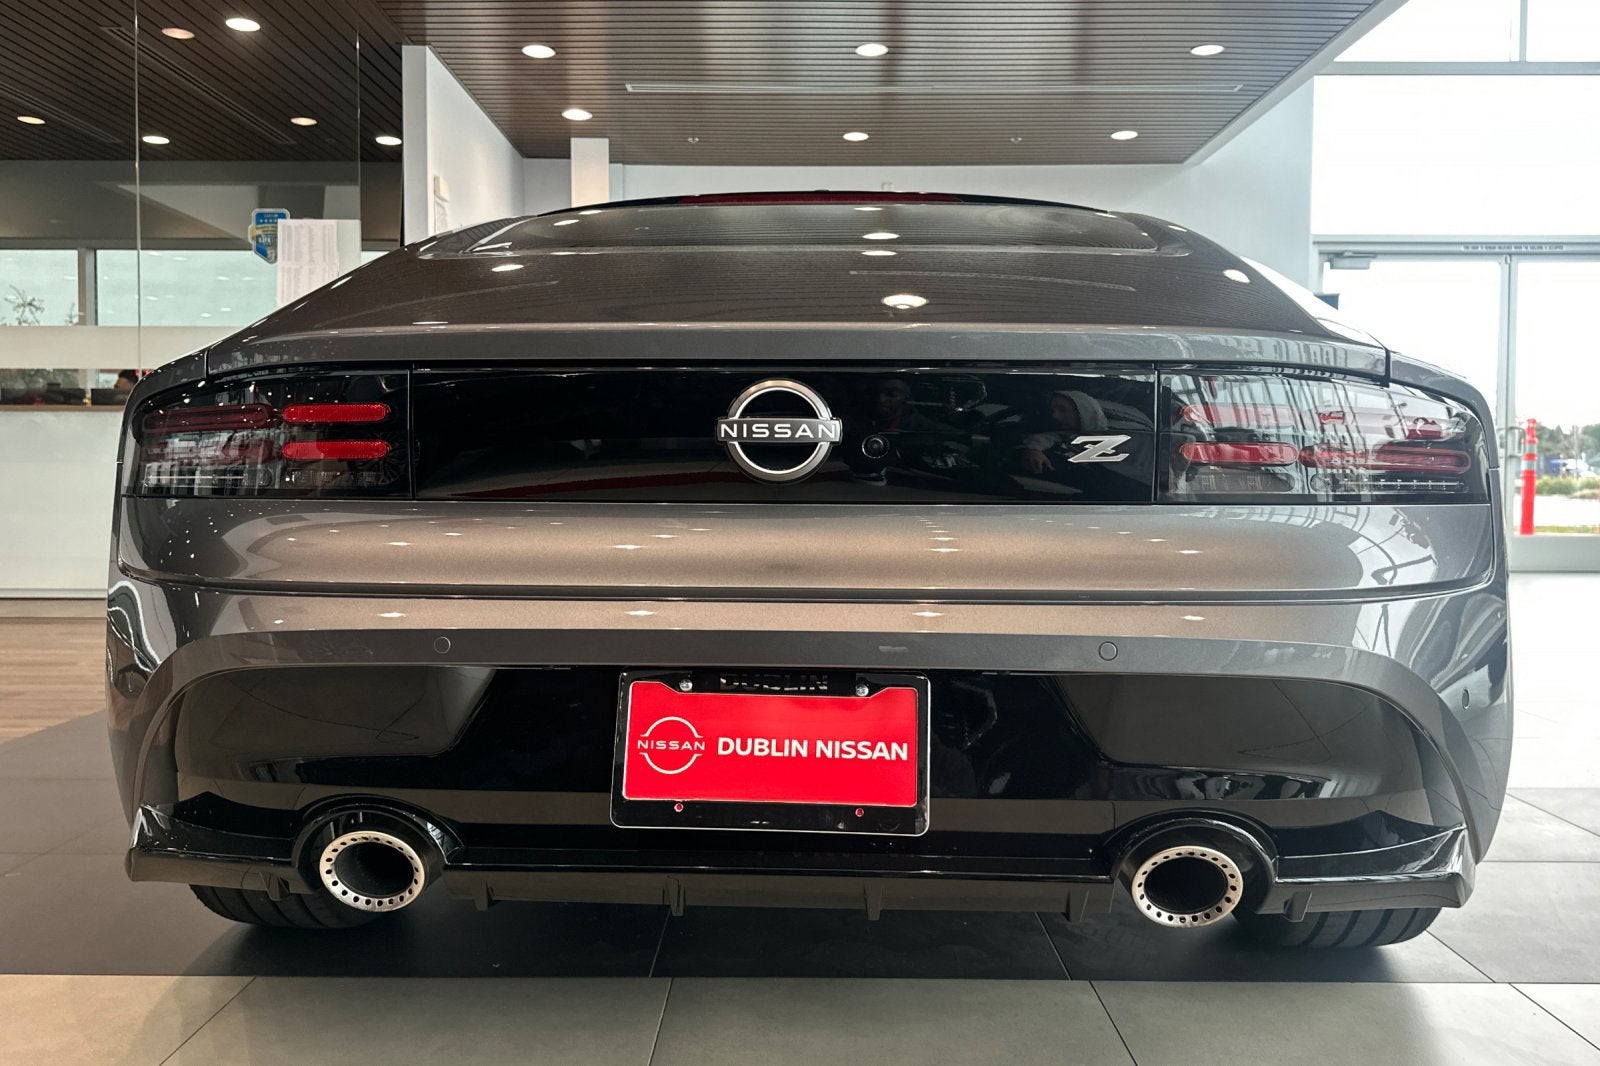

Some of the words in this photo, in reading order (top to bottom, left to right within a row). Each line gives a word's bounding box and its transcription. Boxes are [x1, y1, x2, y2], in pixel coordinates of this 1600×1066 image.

[720, 422, 836, 438] NISSAN
[1067, 435, 1132, 463] Z
[637, 738, 705, 751] NISSAN
[717, 737, 808, 757] DUBLIN
[815, 740, 908, 761] NISSAN
